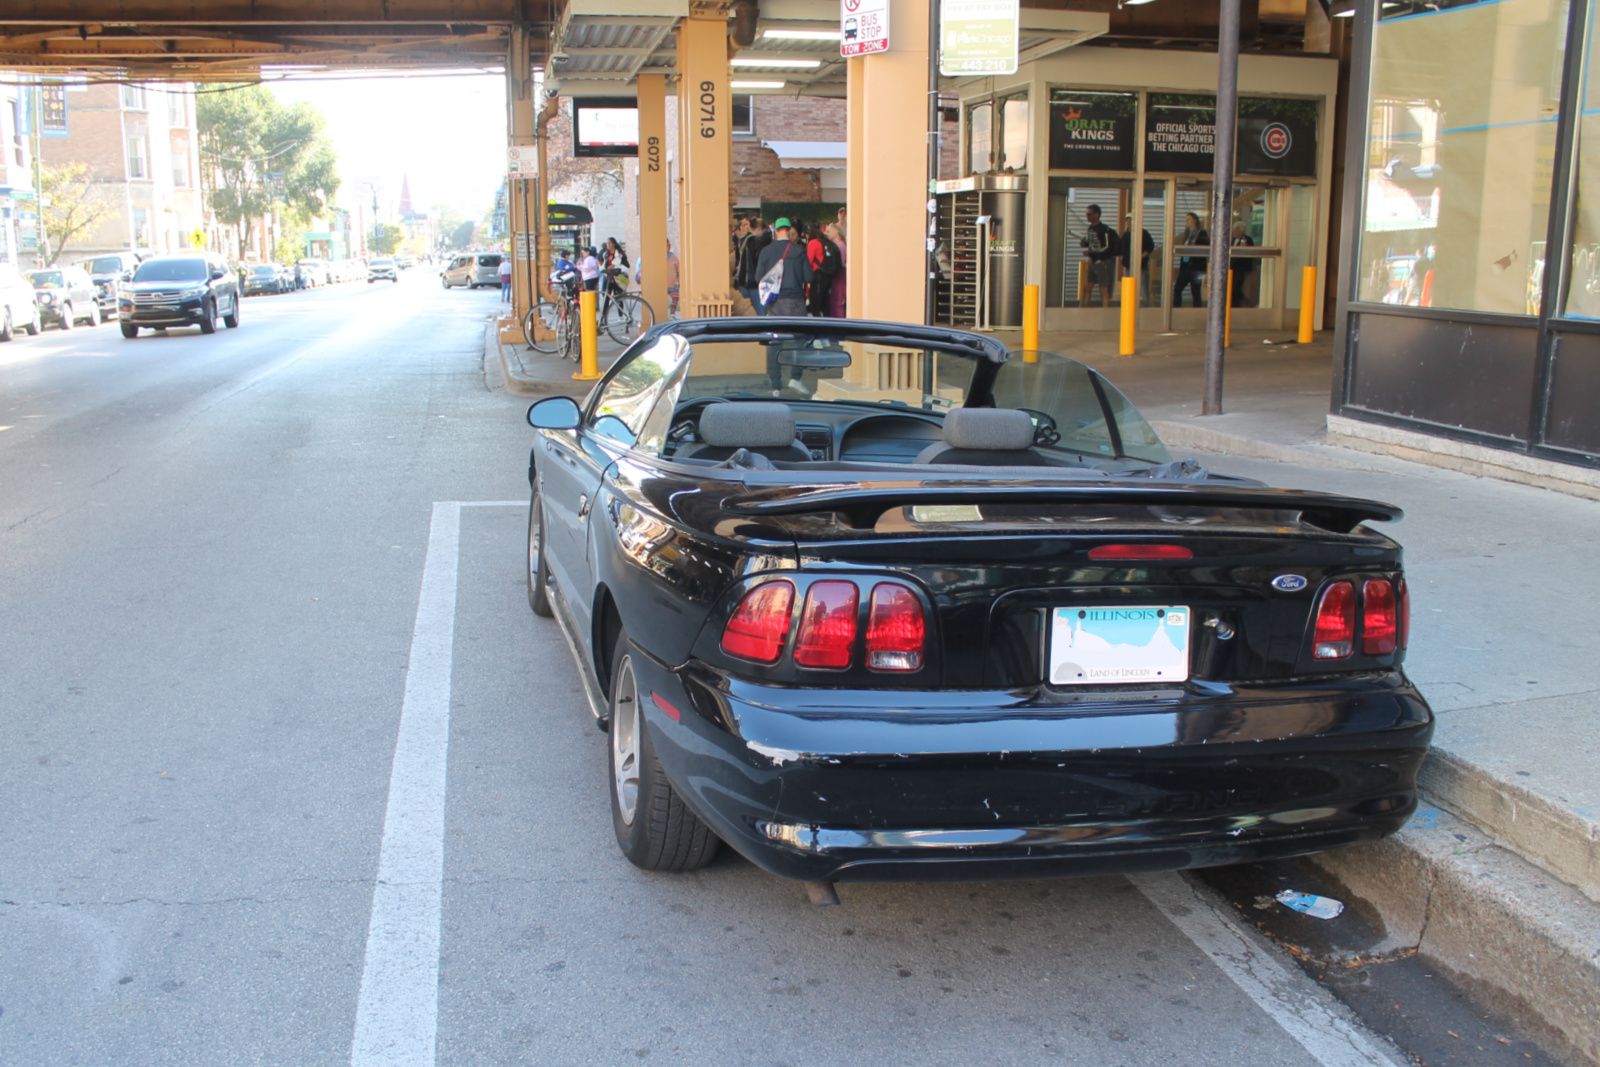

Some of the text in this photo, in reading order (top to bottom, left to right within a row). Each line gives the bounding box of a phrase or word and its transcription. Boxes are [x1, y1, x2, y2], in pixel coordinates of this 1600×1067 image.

[861, 13, 878, 27] BUS
[861, 26, 882, 39] STOP
[844, 40, 884, 55] TOW ZONE
[700, 80, 716, 139] 6071.9
[1065, 118, 1116, 131] DRAFT
[1156, 122, 1187, 133] OFFICIAL
[1071, 128, 1115, 141] KINGS
[1148, 132, 1213, 144] BETTING PARTNER
[647, 136, 660, 172] 6072
[1152, 142, 1215, 154] THE CHICAGO CUB
[1090, 610, 1155, 621] ILLINOIS
[1090, 668, 1110, 677] LAND
[1121, 668, 1151, 677] LINCOLN
